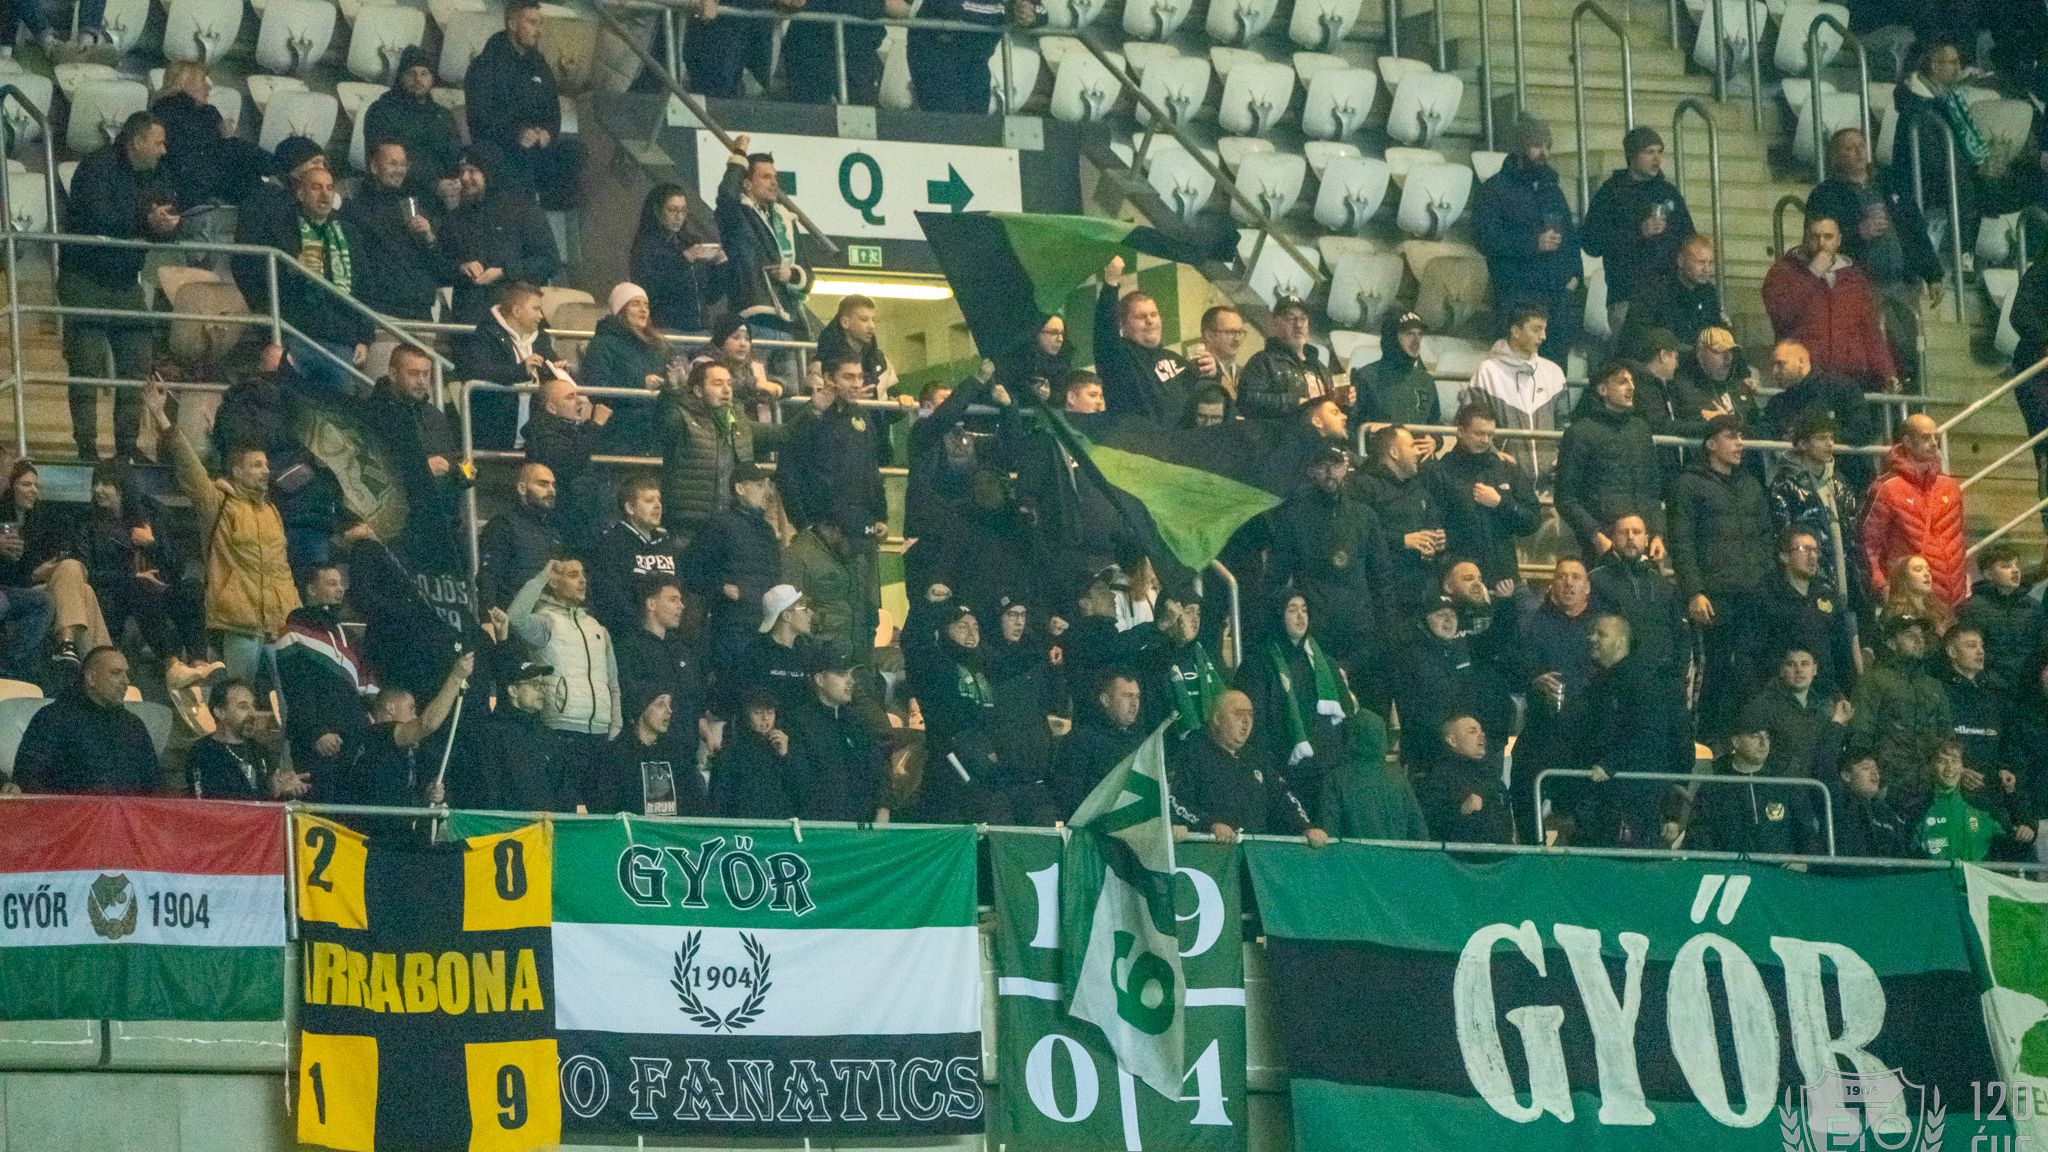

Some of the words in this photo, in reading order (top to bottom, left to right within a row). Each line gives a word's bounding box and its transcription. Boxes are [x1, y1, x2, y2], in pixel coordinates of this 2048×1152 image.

[838, 151, 886, 226] Q
[304, 826, 338, 893] 2
[3, 884, 69, 930] GYŐR
[148, 891, 211, 930] 1904
[1026, 862, 1060, 950] 1
[1174, 867, 1225, 958] 9
[304, 941, 545, 1014] RRABONA
[691, 965, 753, 991] 1904
[1452, 873, 1913, 1135] GYŐR
[496, 1063, 529, 1130] 9
[629, 1055, 985, 1123] FANATICS
[1025, 1032, 1100, 1124] 0
[1178, 1038, 1233, 1126] 4
